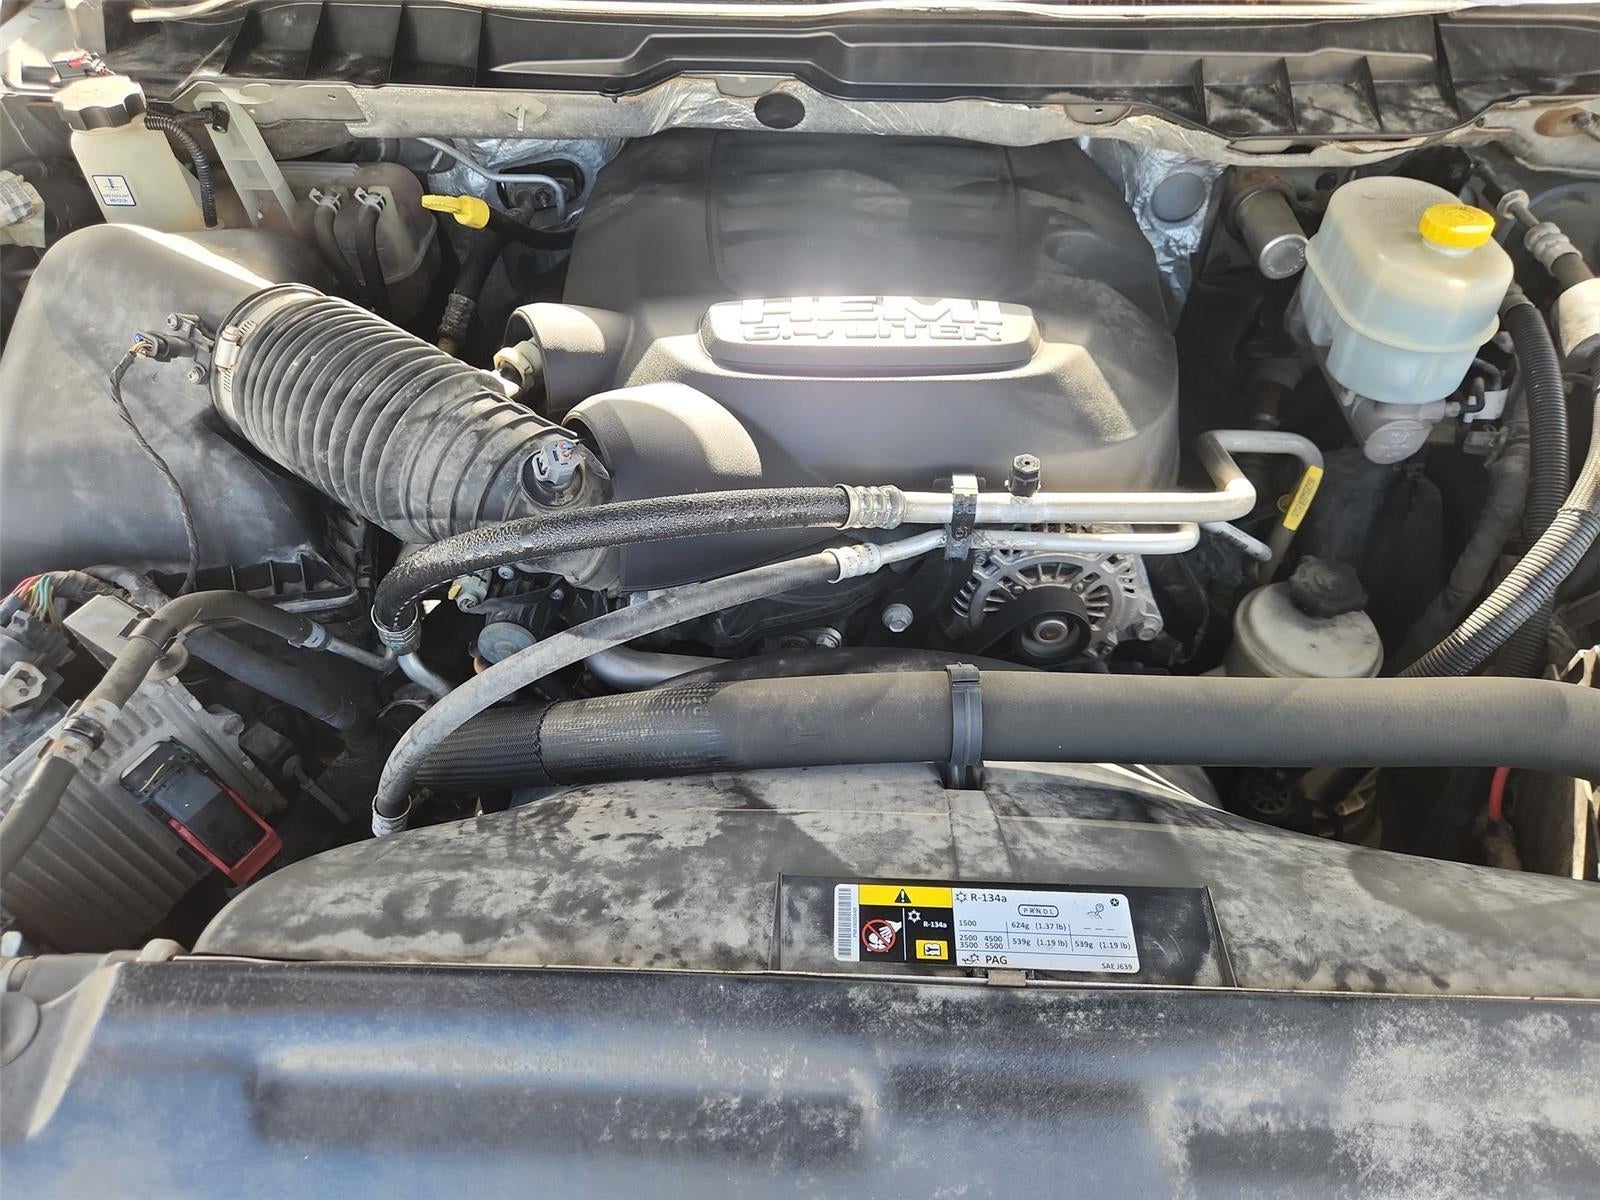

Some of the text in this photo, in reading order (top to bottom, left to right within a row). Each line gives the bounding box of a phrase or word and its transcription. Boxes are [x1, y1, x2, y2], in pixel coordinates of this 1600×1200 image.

[740, 296, 1003, 324] HEMI
[743, 322, 1002, 341] 6.4 LITER
[970, 893, 1007, 903] R-134a
[923, 920, 948, 929] R-134a
[959, 919, 977, 927] 1500
[1011, 921, 1067, 932] 624g (1.37 lb)
[984, 935, 1003, 943] 4500
[1012, 937, 1068, 949] 539g (1.19 lb)
[960, 941, 1004, 950] 3500 5500
[1074, 940, 1131, 951] 539g (1.19 lb)
[985, 955, 1008, 965] PAG
[1116, 963, 1133, 971] J639
